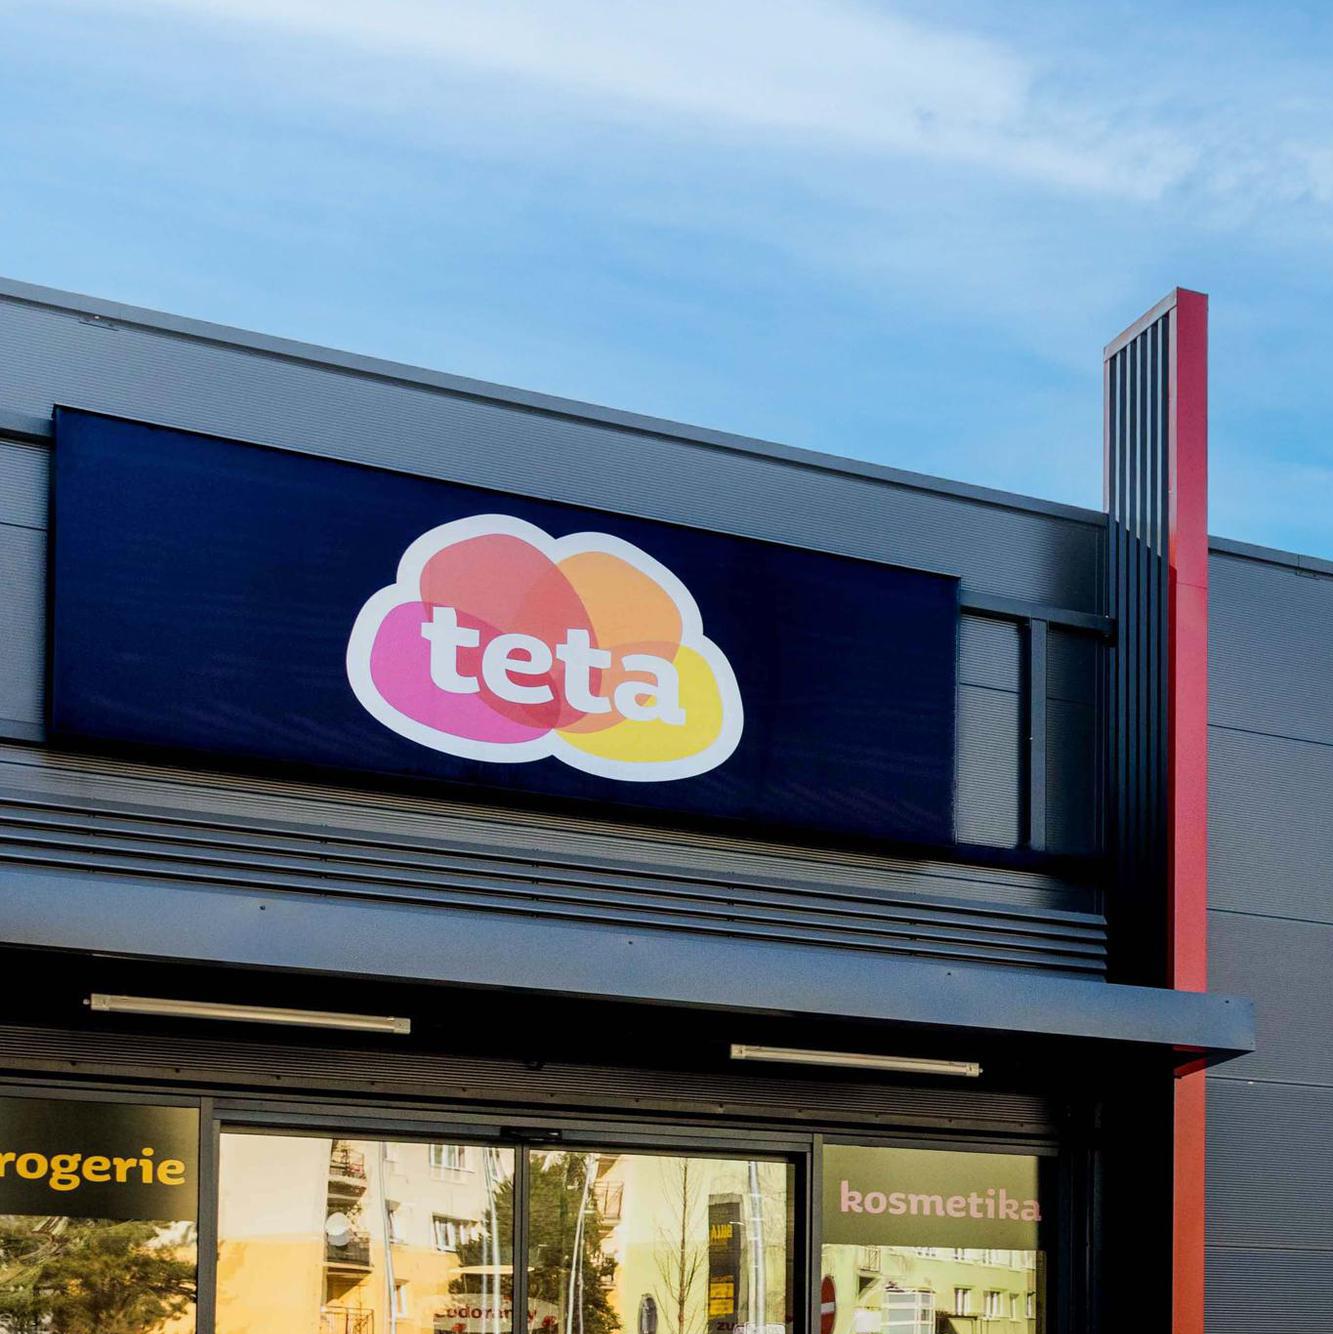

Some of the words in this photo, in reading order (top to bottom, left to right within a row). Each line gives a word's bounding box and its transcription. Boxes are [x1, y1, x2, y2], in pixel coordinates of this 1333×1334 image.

[421, 606, 686, 727] teta
[0, 1148, 186, 1191] rogerie
[840, 1180, 1042, 1222] kosmetika
